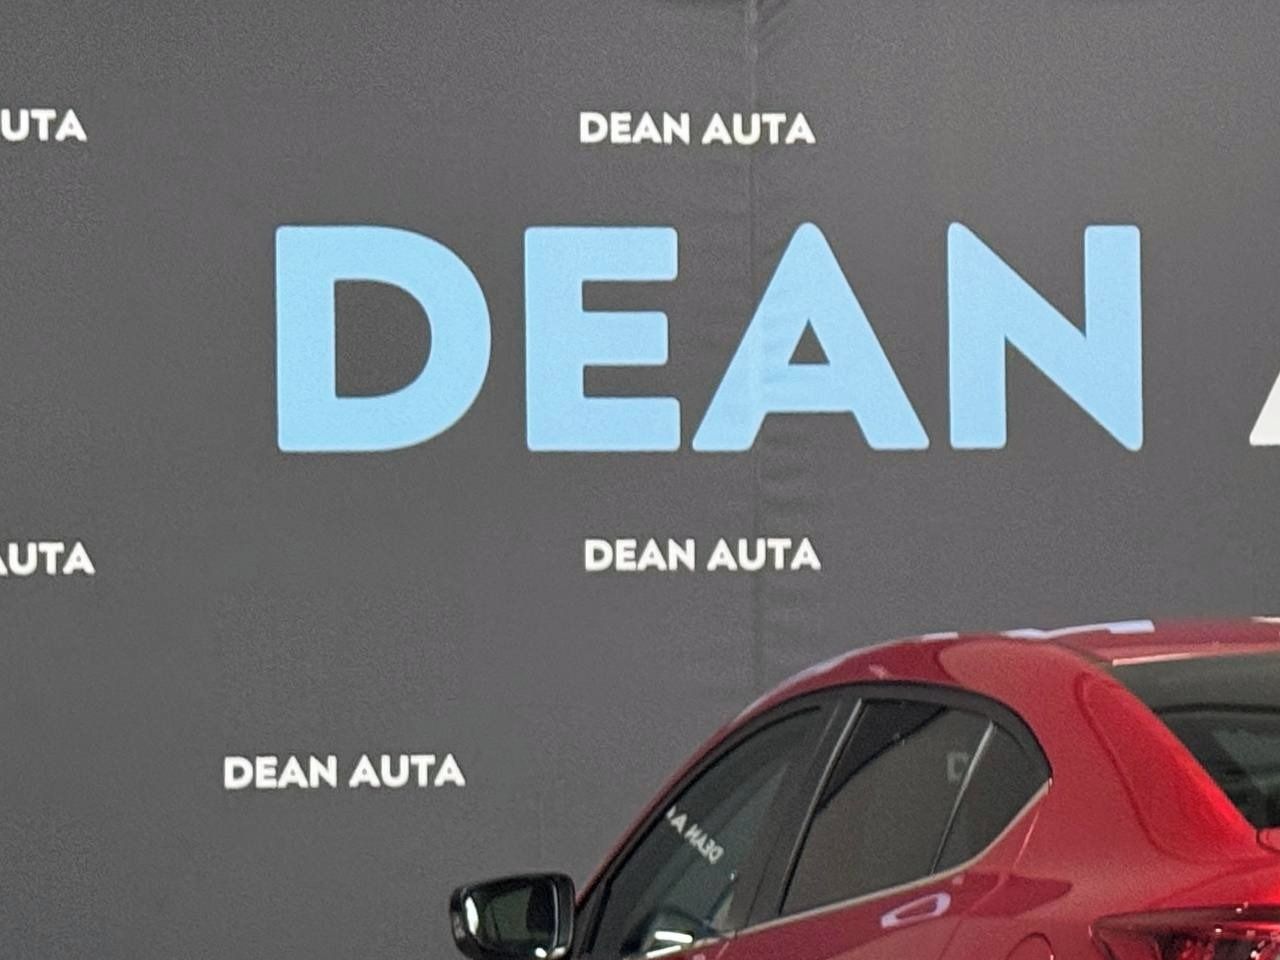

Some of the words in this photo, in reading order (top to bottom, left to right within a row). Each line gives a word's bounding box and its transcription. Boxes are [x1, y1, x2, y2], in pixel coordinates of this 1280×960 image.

[579, 111, 691, 146] DEAN
[700, 111, 817, 146] AUTA
[274, 221, 1144, 454] DEAN
[0, 541, 97, 577] UTA
[584, 537, 696, 573] DEAN
[706, 536, 822, 572] AUTA
[223, 754, 338, 790] DEAN
[348, 752, 466, 788] AUTA
